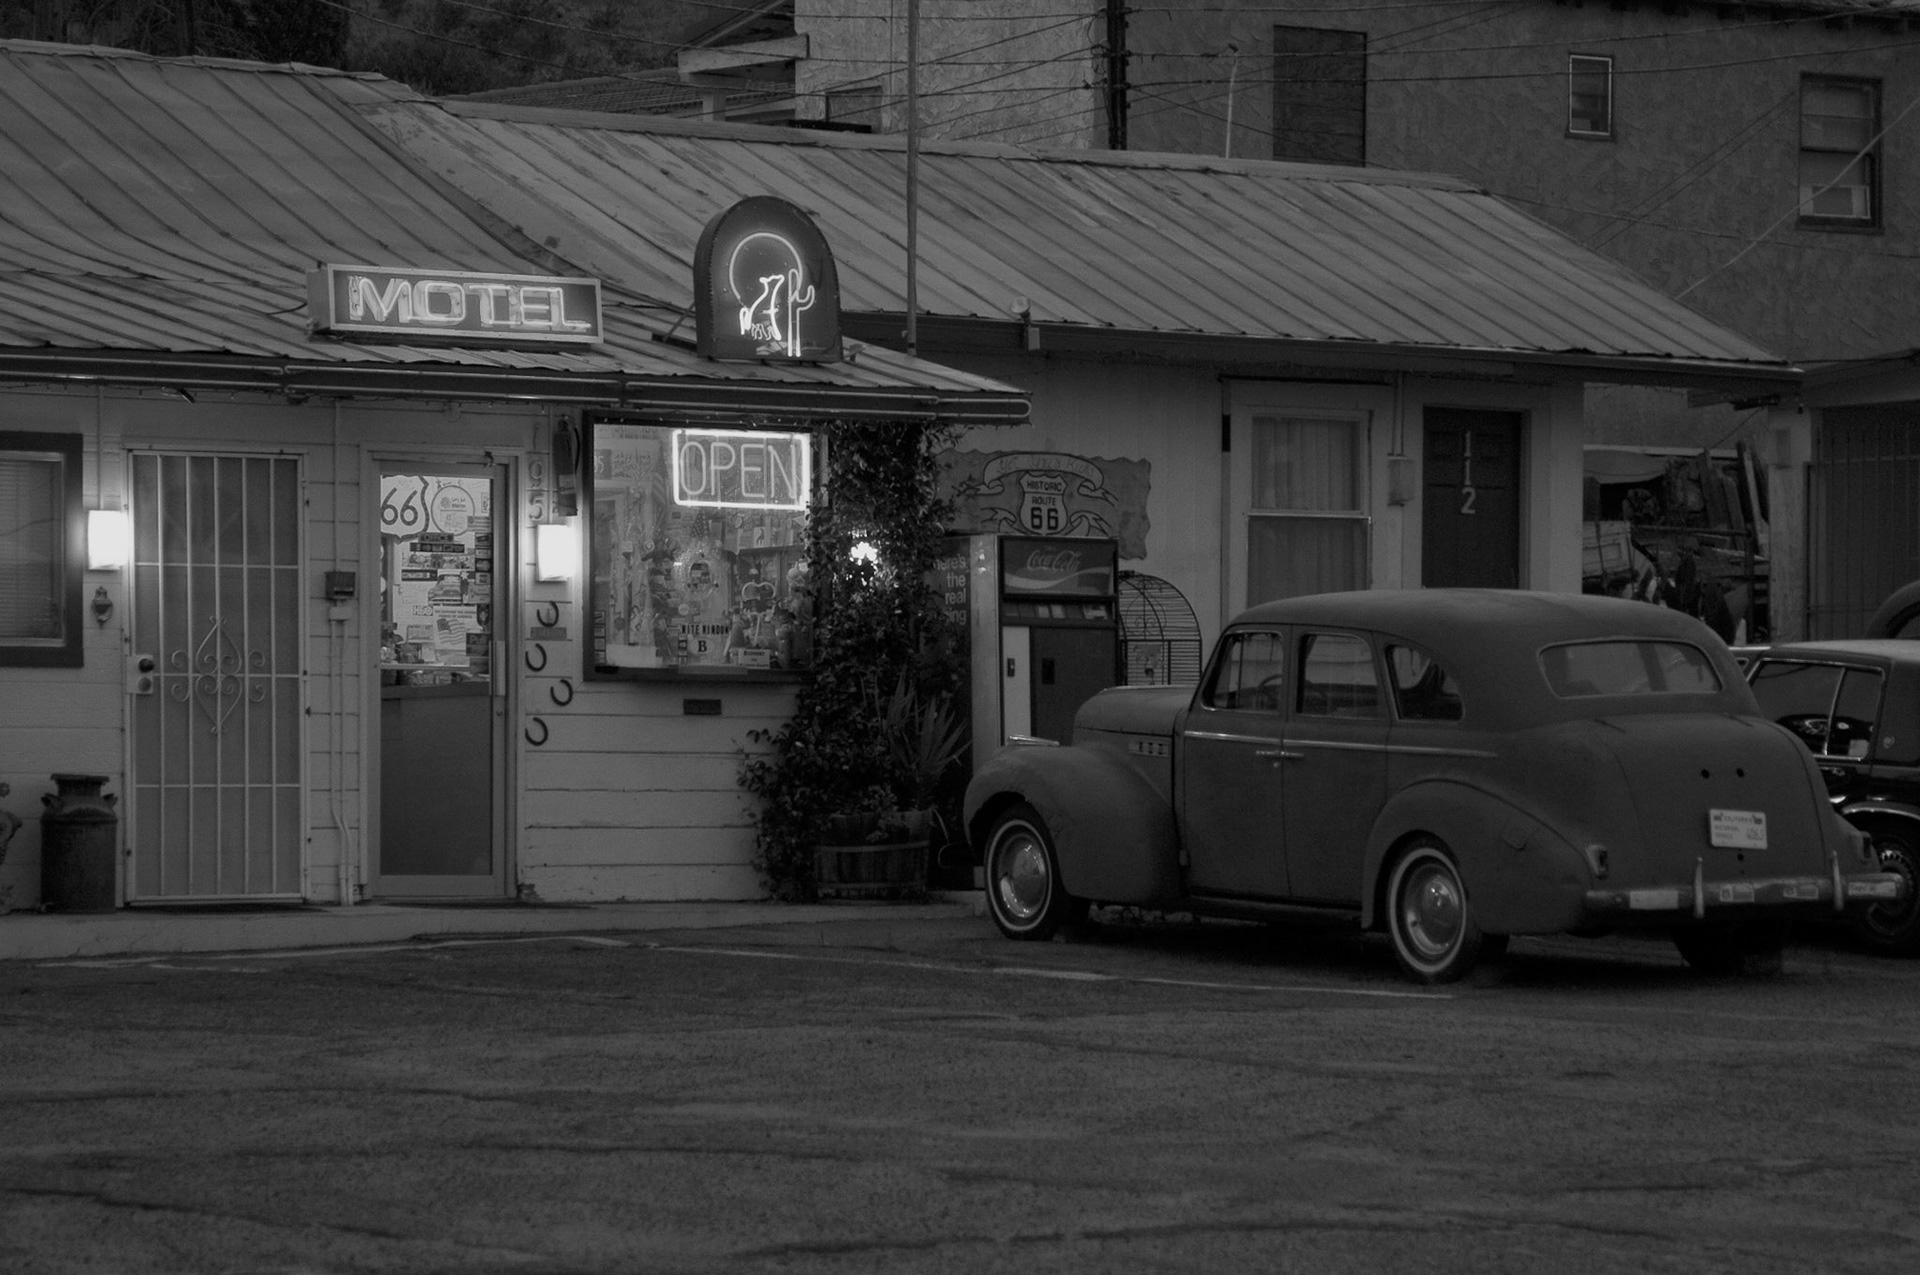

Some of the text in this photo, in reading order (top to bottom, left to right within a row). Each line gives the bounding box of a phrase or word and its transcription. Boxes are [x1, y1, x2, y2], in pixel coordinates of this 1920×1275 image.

[348, 276, 591, 332] MOTEL
[680, 441, 798, 499] OPEN
[1460, 430, 1477, 515] 112
[1026, 480, 1063, 493] HISTORIC
[380, 487, 418, 526] 66
[1031, 496, 1057, 507] ROUTE
[1030, 507, 1059, 531] 66
[1026, 548, 1082, 574] Coca-Cola
[946, 571, 966, 588] the
[944, 588, 966, 605] real
